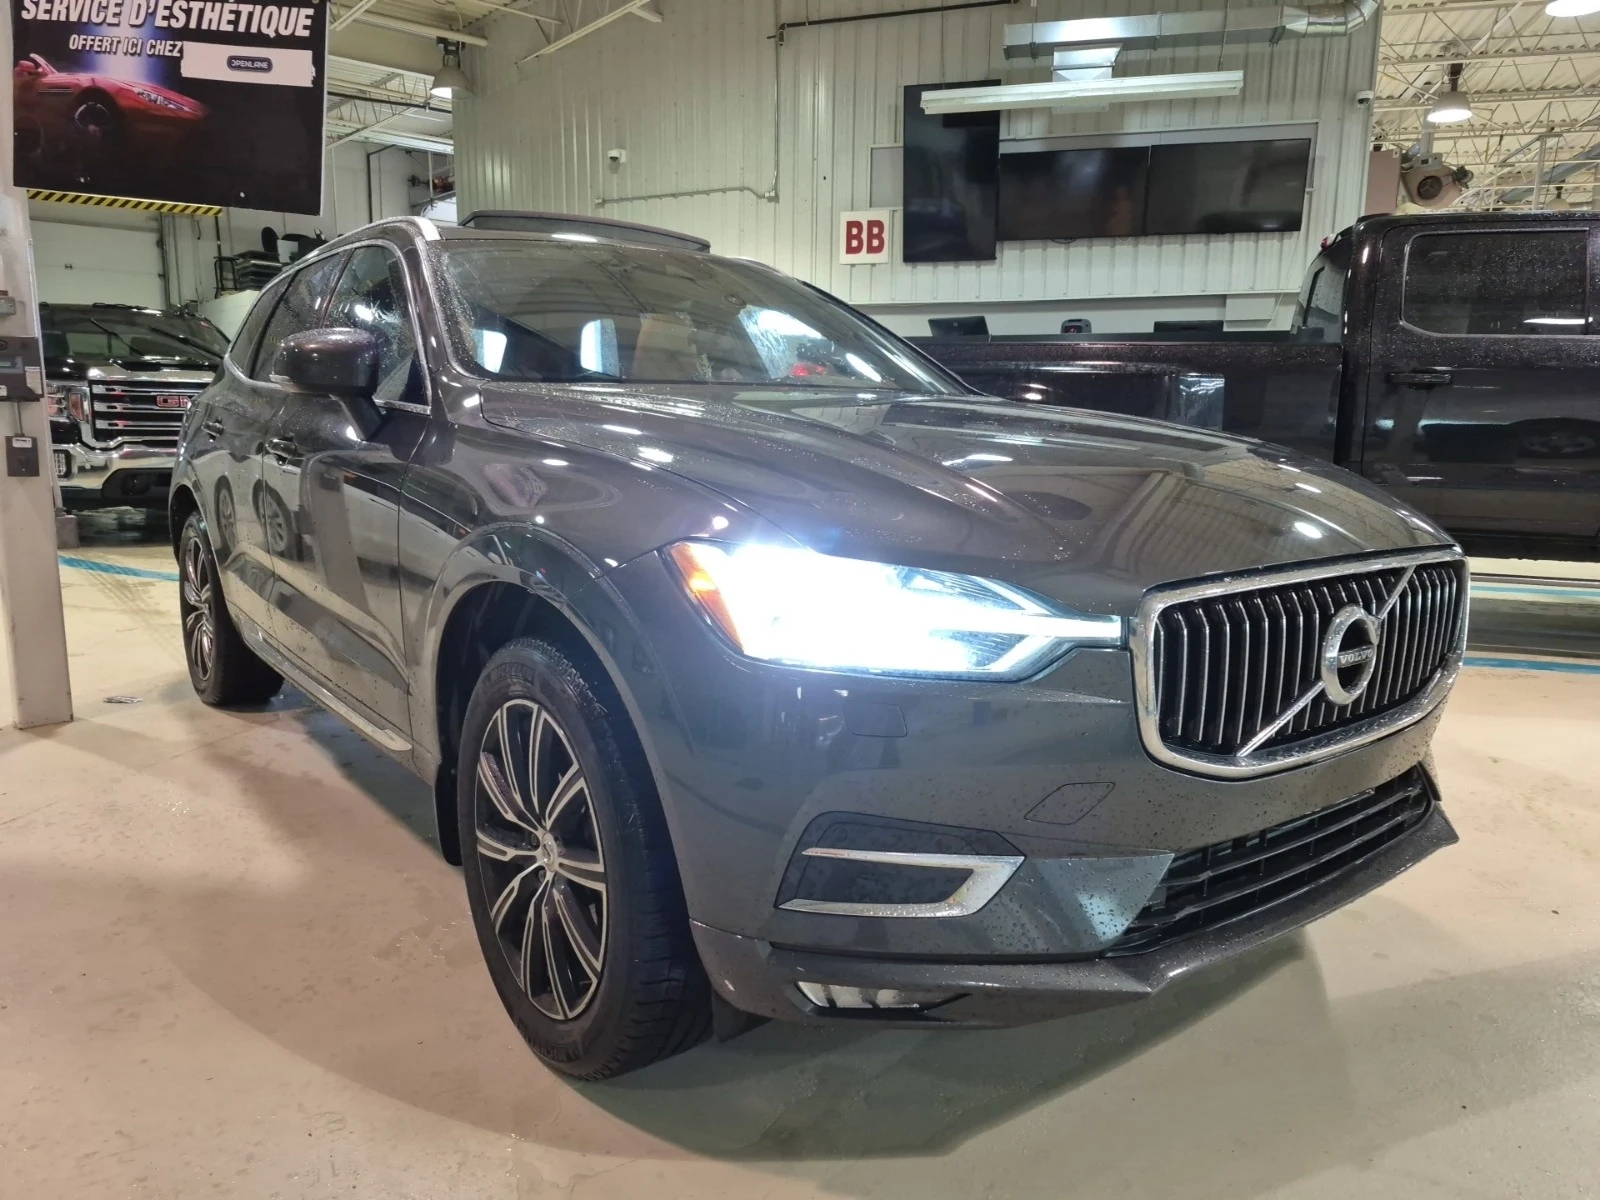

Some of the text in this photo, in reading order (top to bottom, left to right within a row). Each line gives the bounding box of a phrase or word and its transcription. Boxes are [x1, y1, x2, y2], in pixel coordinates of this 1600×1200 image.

[21, 0, 122, 24] SERVICE
[69, 34, 183, 57] OFFERT ICI CHEZ
[845, 219, 885, 255] BB
[1339, 649, 1373, 664] VOLVO
